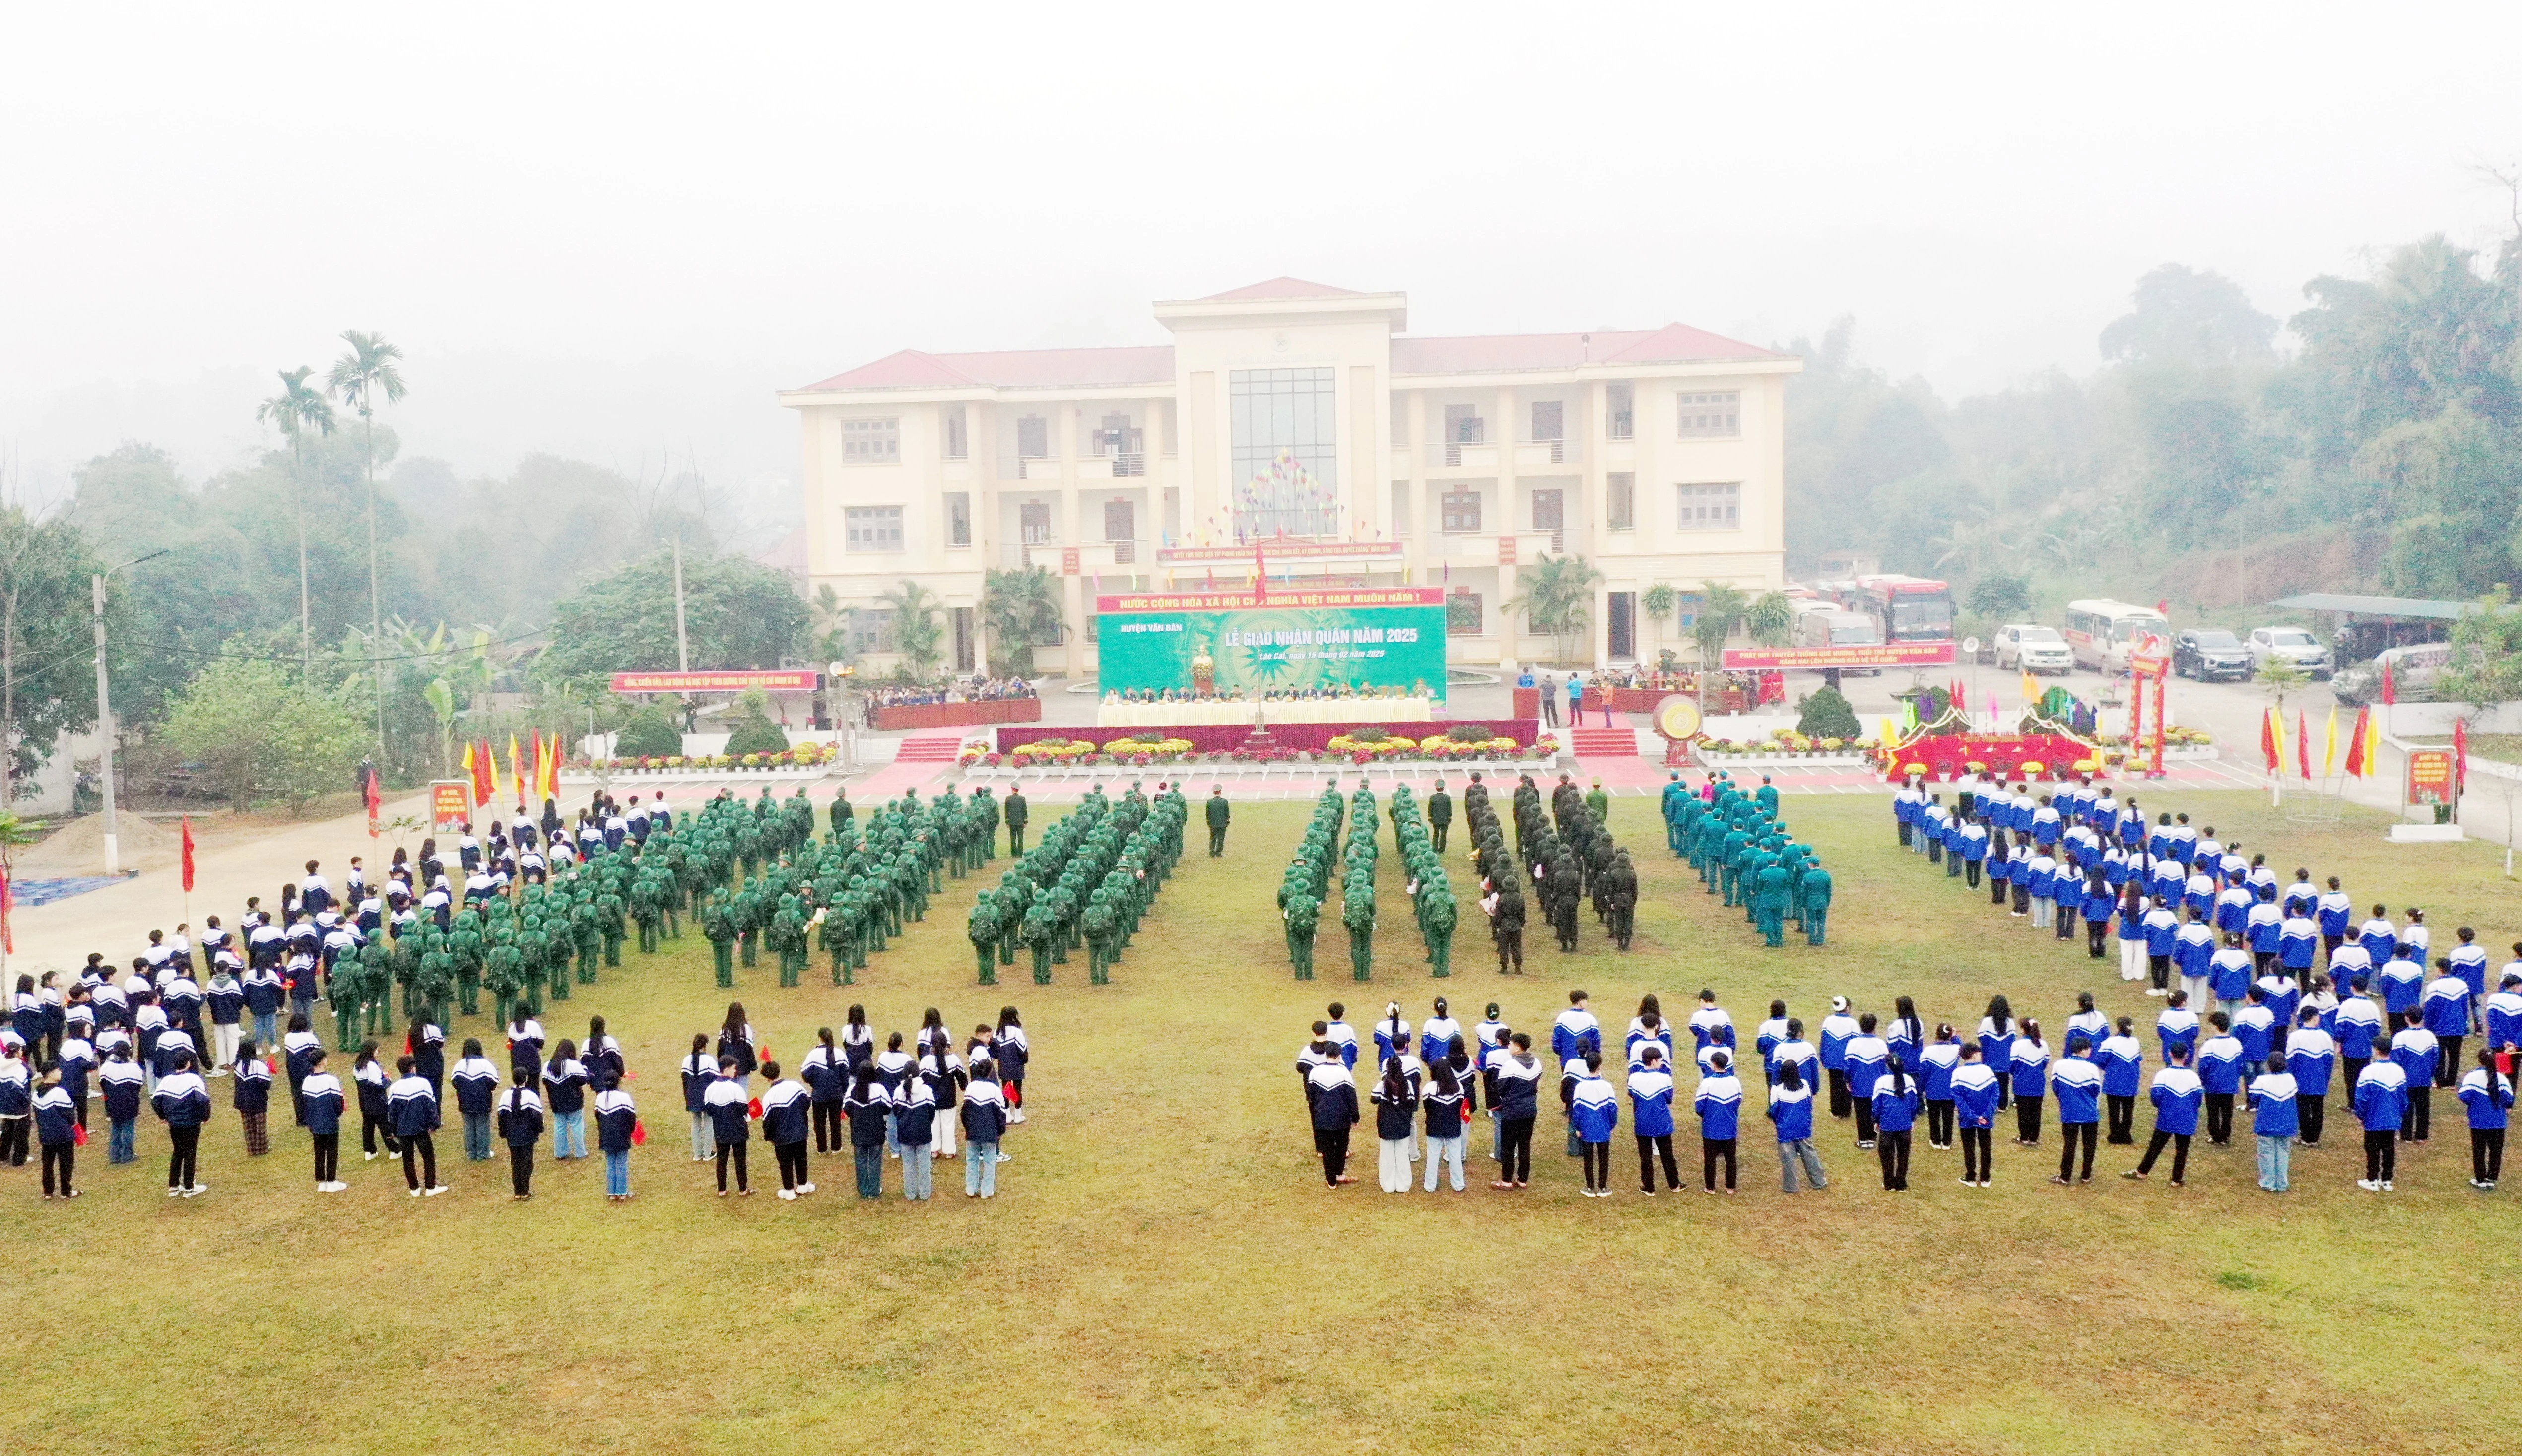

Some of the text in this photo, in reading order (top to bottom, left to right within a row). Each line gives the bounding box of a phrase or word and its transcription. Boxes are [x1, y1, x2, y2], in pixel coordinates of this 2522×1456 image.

[1120, 597, 1148, 609] NƯỚC
[1151, 597, 1179, 610] CỘNG
[1182, 597, 1203, 608] HÒA
[1205, 596, 1220, 607] XÃ
[1222, 596, 1240, 608] HỘI
[1266, 595, 1299, 605] NGHĨA
[1301, 594, 1324, 606] VIỆT
[1326, 595, 1351, 604] NAM
[1354, 593, 1385, 603] MUÔN
[1388, 592, 1413, 602] NĂM
[1121, 623, 1183, 634] HUYỆN VĂN BÀN
[1225, 626, 1418, 648] LỄ GIAO NHẬN QUÂN NĂM 2025
[1366, 650, 1385, 658] 2025
[1887, 647, 1908, 656] HUYỆN
